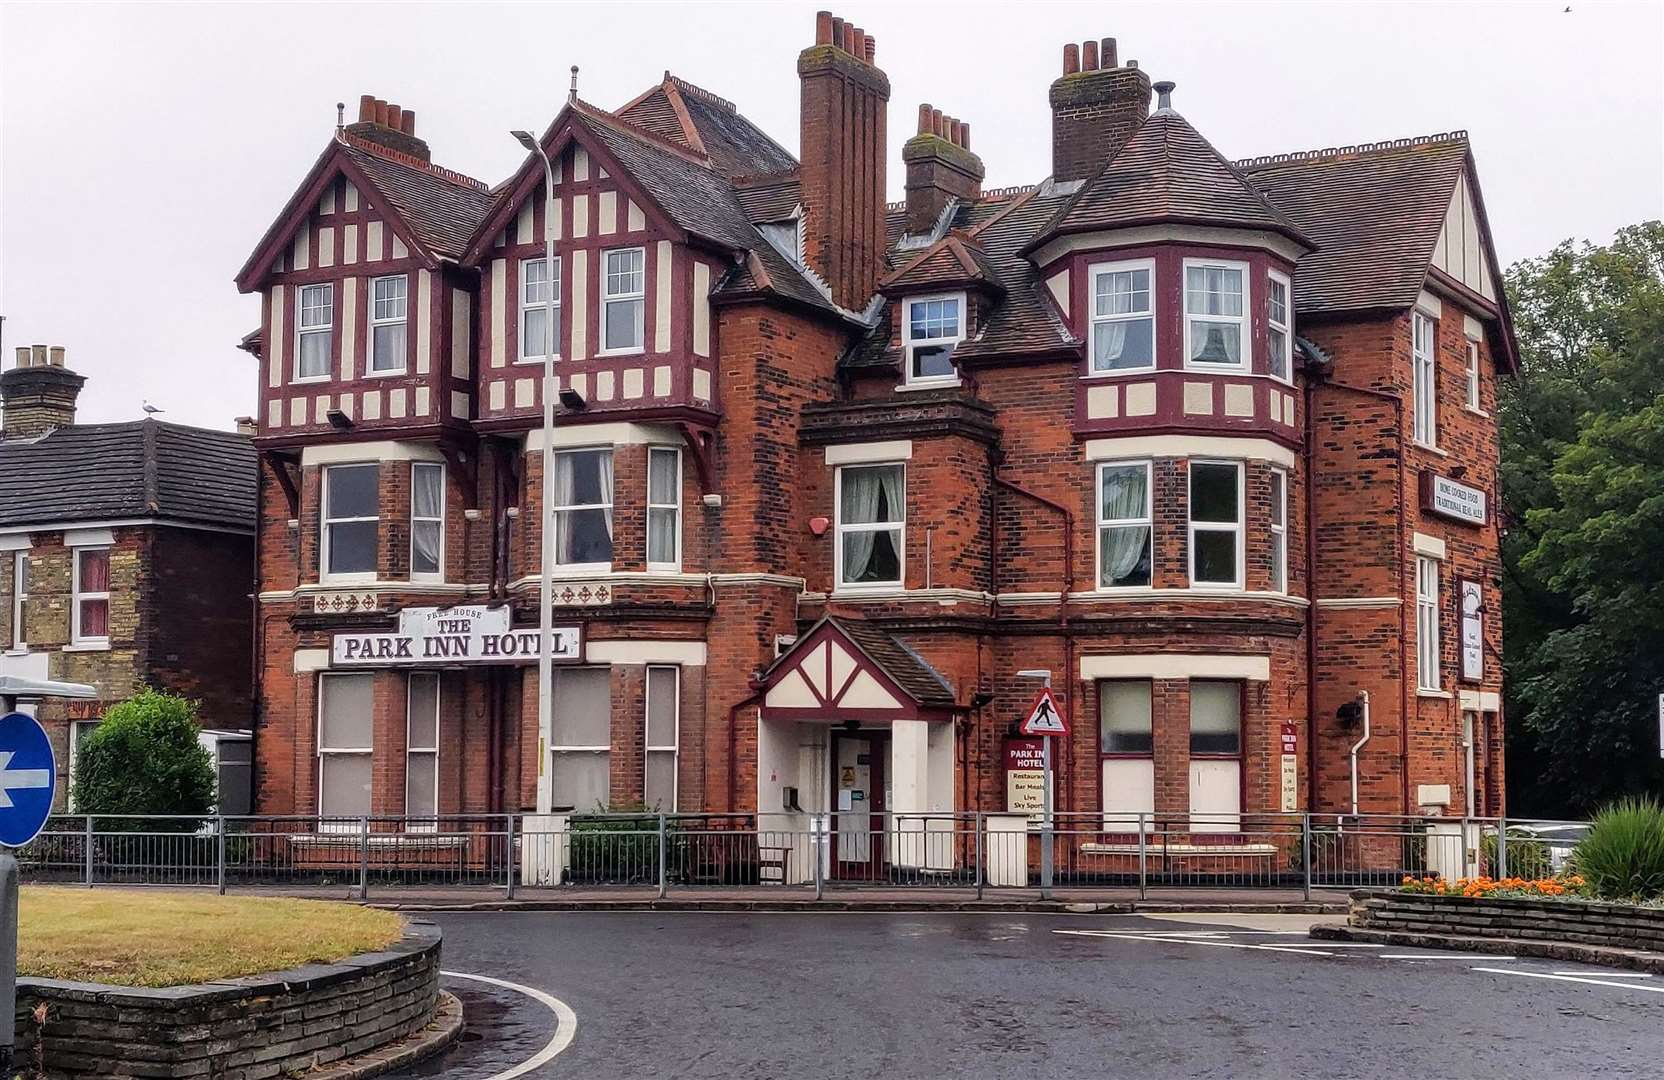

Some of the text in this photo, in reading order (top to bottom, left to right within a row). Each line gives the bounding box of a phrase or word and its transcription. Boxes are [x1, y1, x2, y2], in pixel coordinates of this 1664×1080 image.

[453, 608, 482, 619] HOUSE
[437, 619, 472, 634] THE
[344, 637, 413, 660] PARK
[423, 635, 471, 657] INN
[1010, 750, 1045, 758] PARK IN
